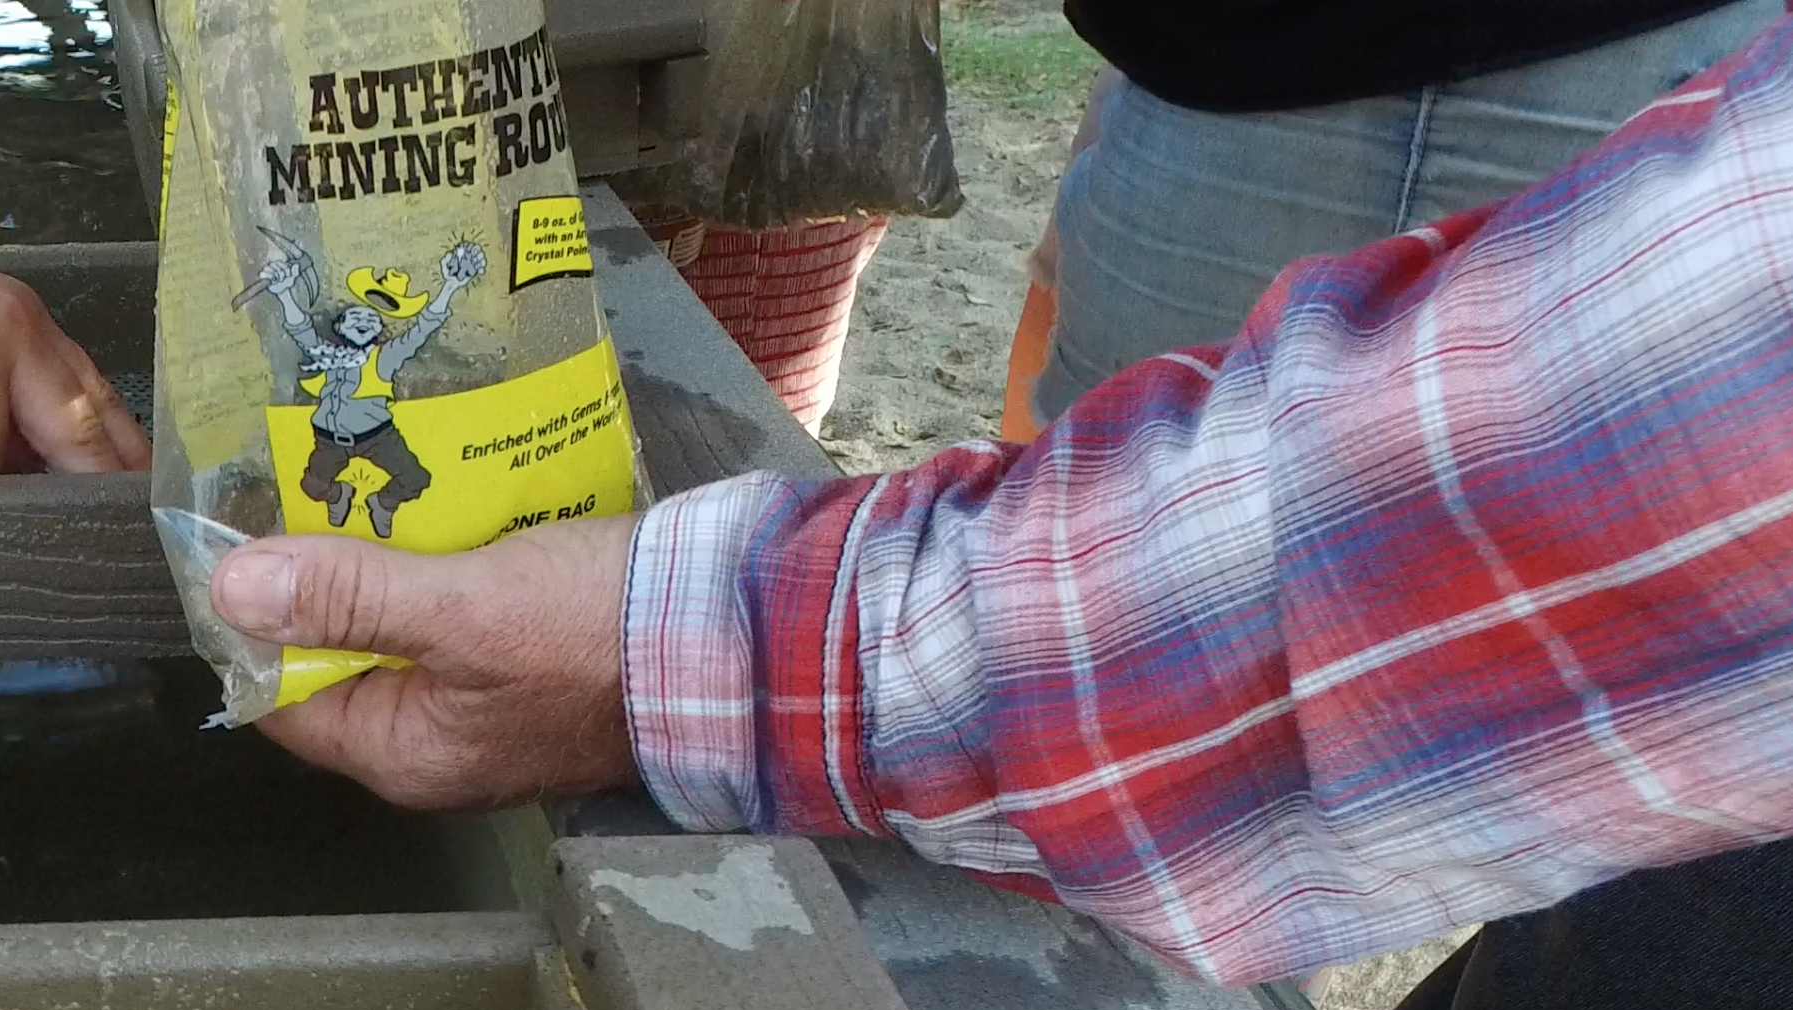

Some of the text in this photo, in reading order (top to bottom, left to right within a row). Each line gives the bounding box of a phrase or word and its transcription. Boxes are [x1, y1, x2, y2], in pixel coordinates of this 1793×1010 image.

[266, 122, 475, 206] MINING
[493, 93, 567, 177] ROU
[526, 247, 564, 263] Crystal
[534, 232, 557, 245] with
[561, 232, 573, 242] an
[462, 398, 602, 461] Enriched with Gems
[509, 450, 531, 471] All
[535, 437, 567, 462] Over
[570, 425, 589, 446] the
